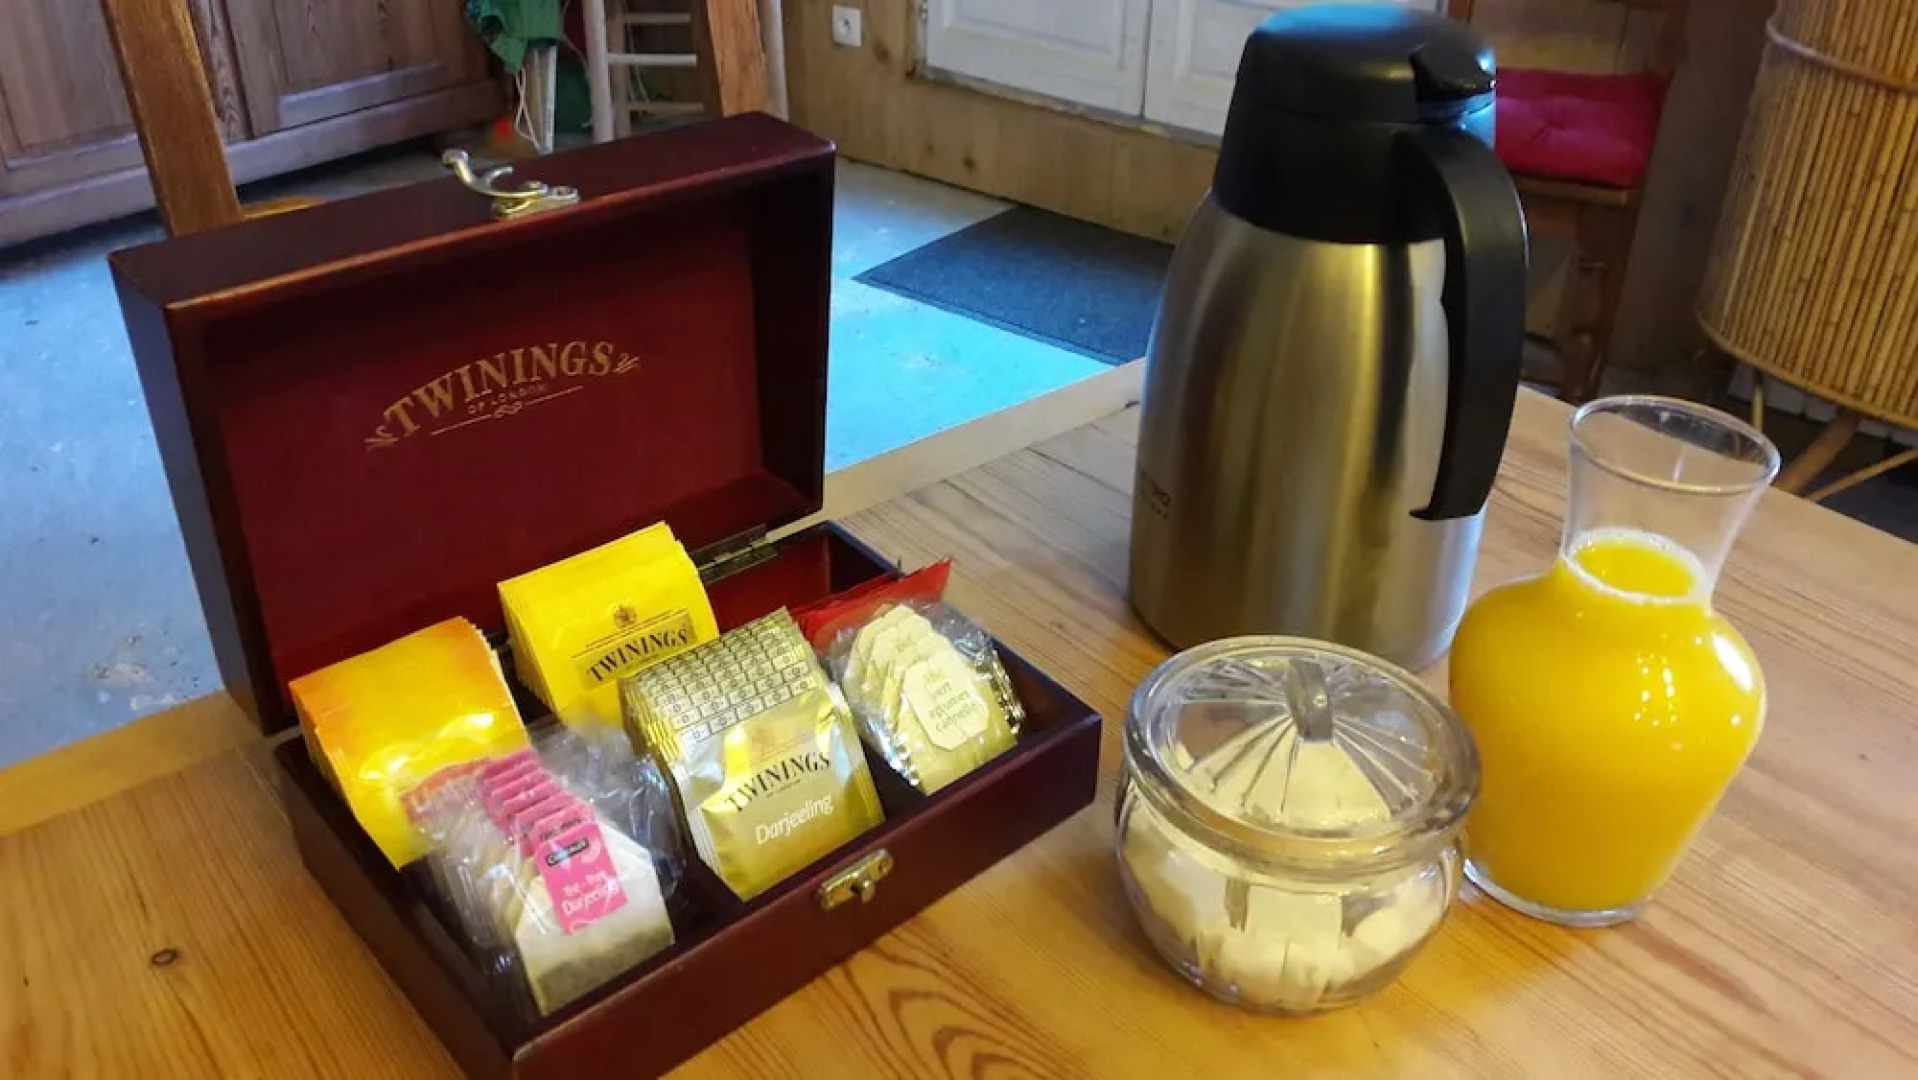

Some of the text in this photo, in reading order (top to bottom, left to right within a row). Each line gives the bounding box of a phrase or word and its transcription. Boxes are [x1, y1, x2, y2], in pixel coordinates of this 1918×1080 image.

[383, 340, 614, 437] TWININGS
[586, 628, 688, 682] TWININGS
[725, 751, 831, 812] TWININGS
[755, 794, 834, 845] Darjeeling
